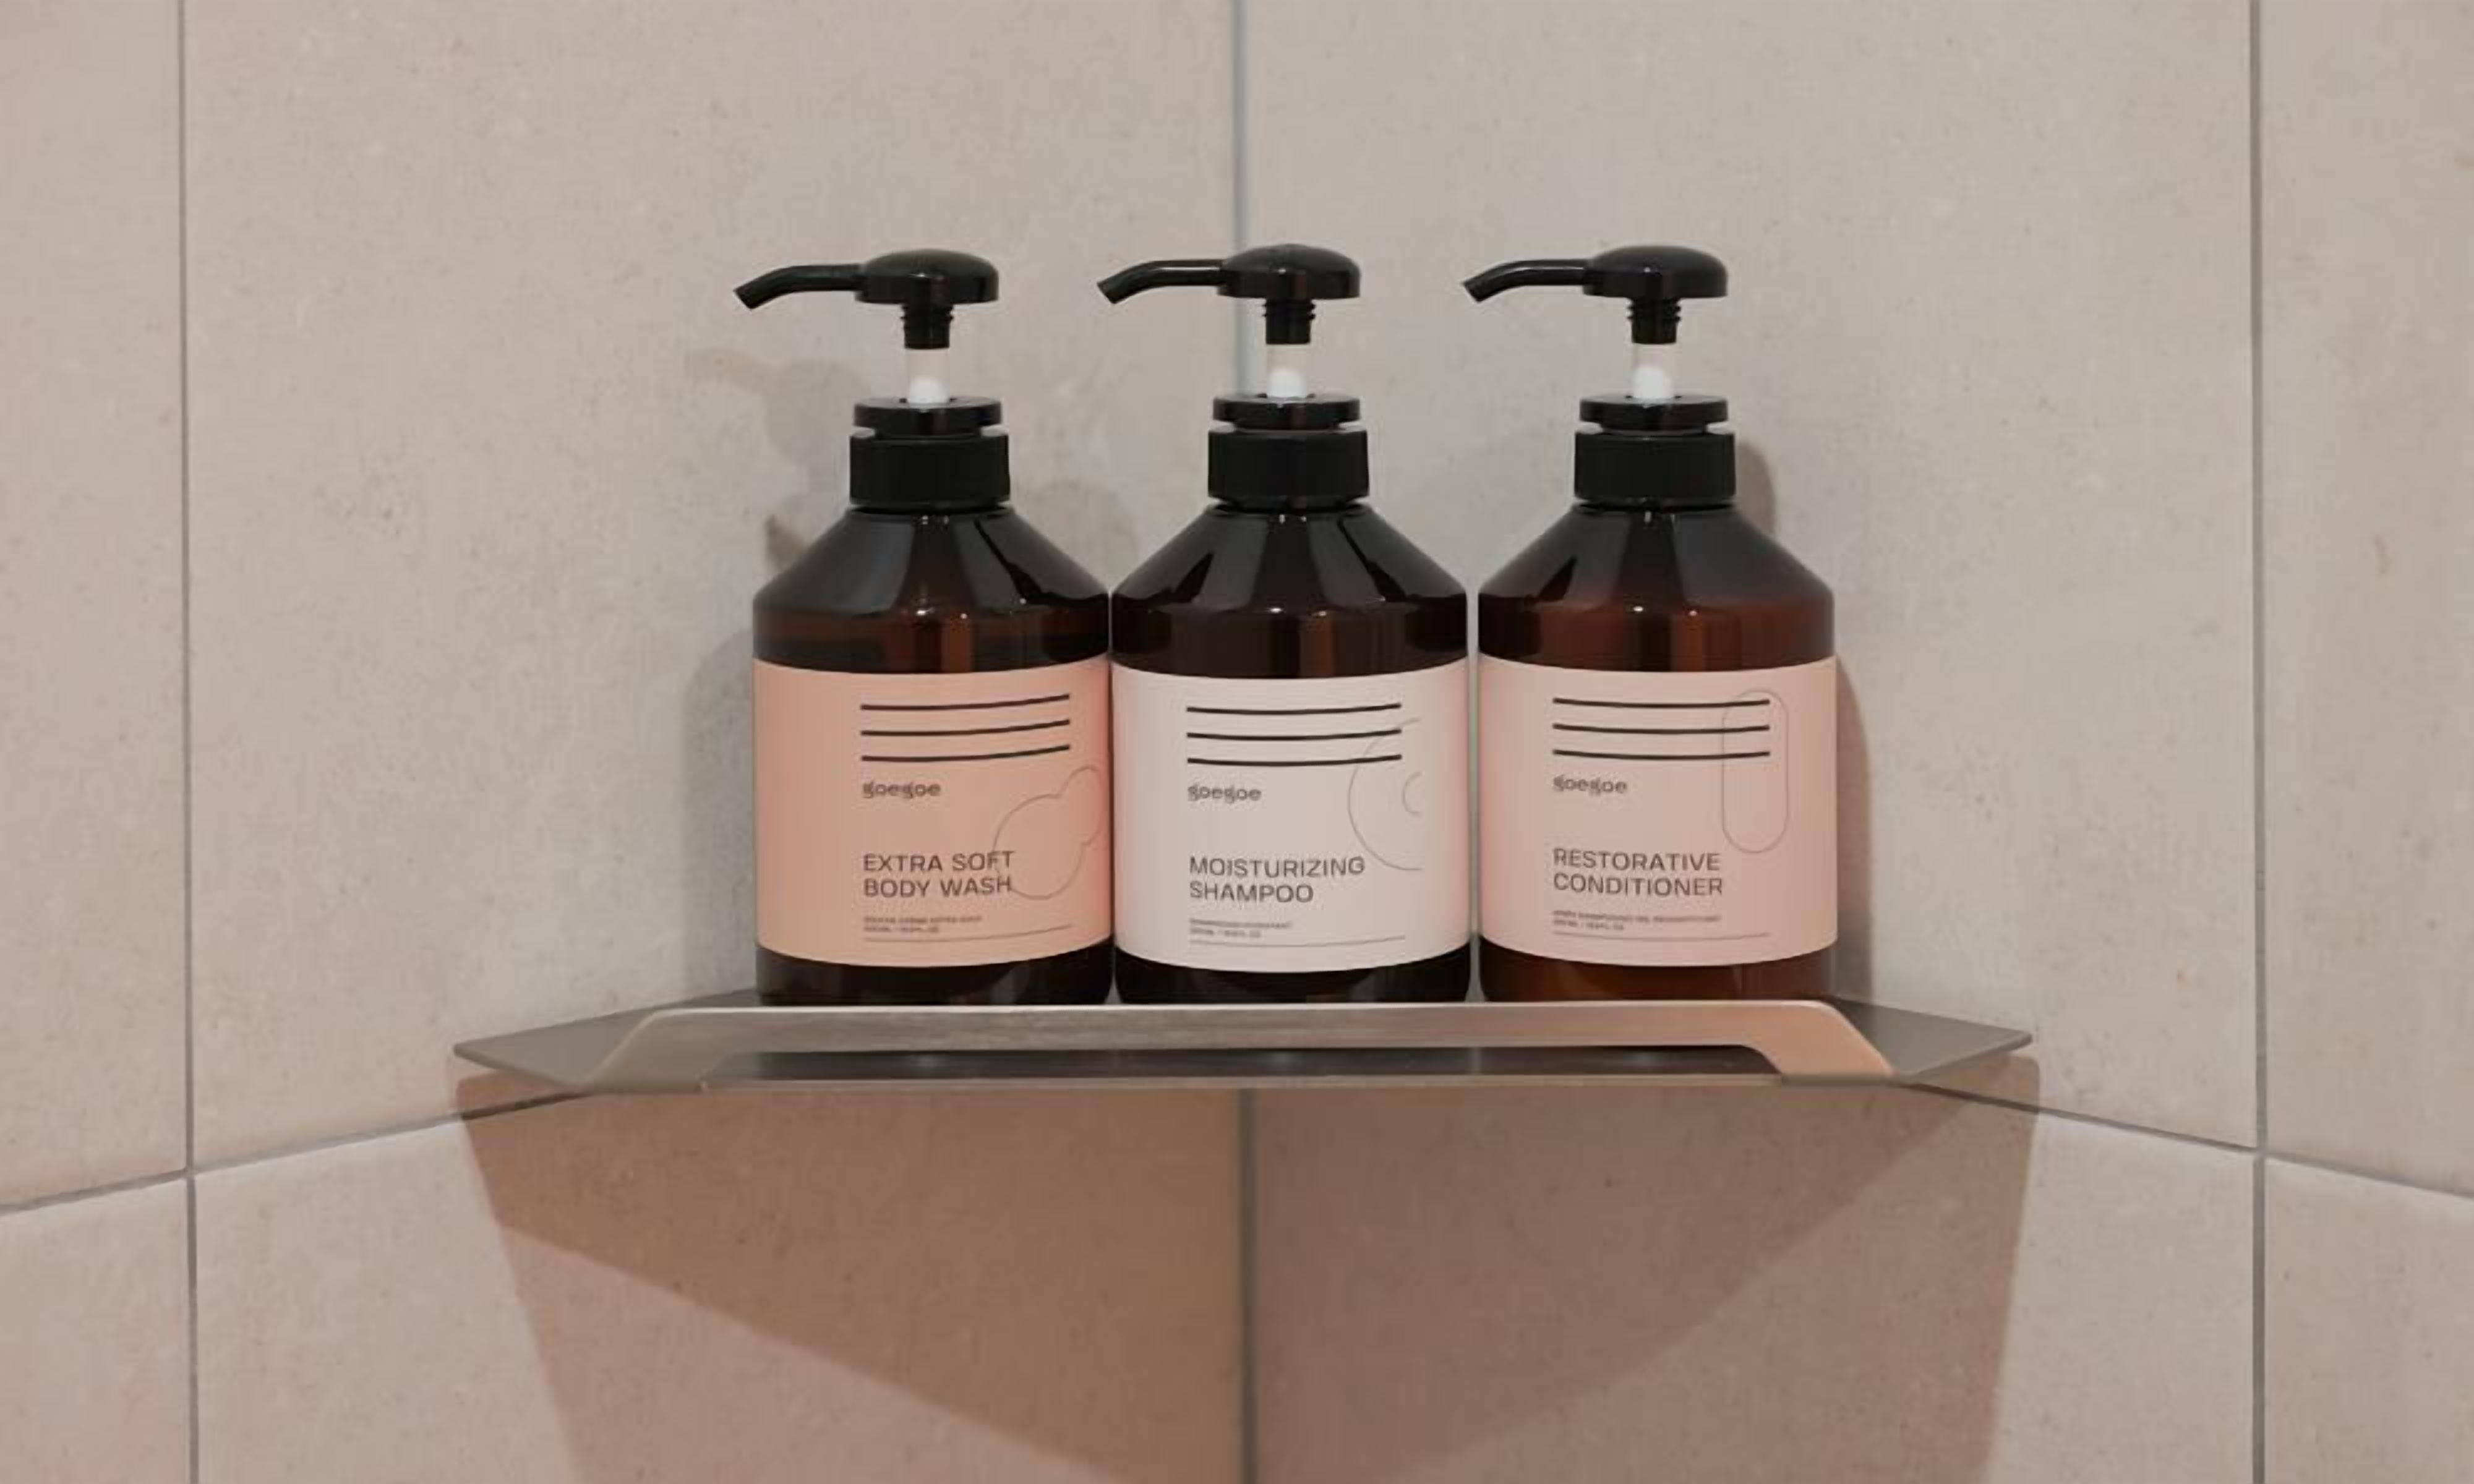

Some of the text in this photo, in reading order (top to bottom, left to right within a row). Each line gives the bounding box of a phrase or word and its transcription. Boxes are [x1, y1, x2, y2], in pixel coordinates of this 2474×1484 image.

[863, 850, 1015, 872] EXTRA SOFT
[1189, 856, 1366, 879] MOISTURIZING
[1553, 847, 1719, 872] RESTORATIVE
[863, 876, 1012, 898] BODY WASH
[1190, 880, 1314, 903] SHAMPOO
[1553, 872, 1723, 897] CONDITIONER
